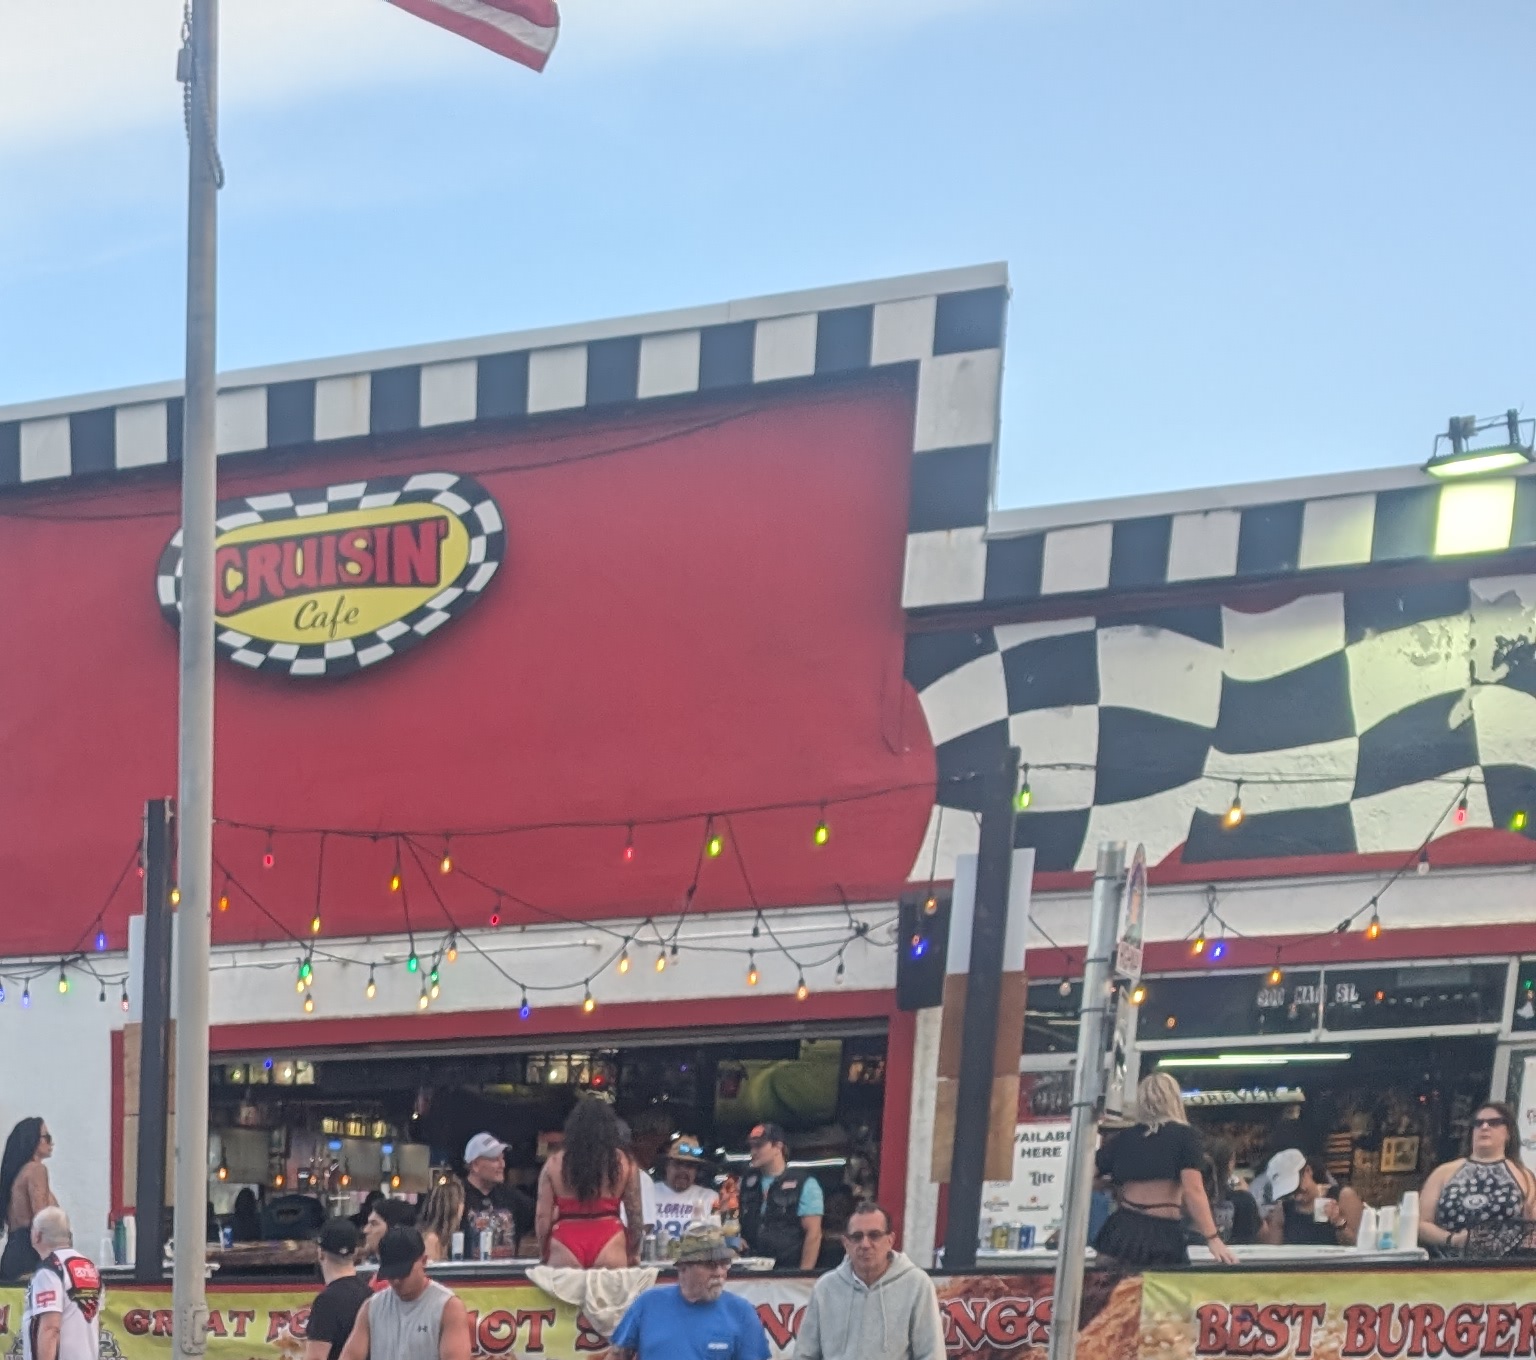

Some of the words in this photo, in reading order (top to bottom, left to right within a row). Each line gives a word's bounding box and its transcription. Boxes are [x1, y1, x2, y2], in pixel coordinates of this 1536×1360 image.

[293, 595, 360, 639] Cafe
[1020, 1147, 1062, 1159] HERE
[122, 1308, 255, 1338] GRAT
[1195, 1302, 1327, 1357] BEST
